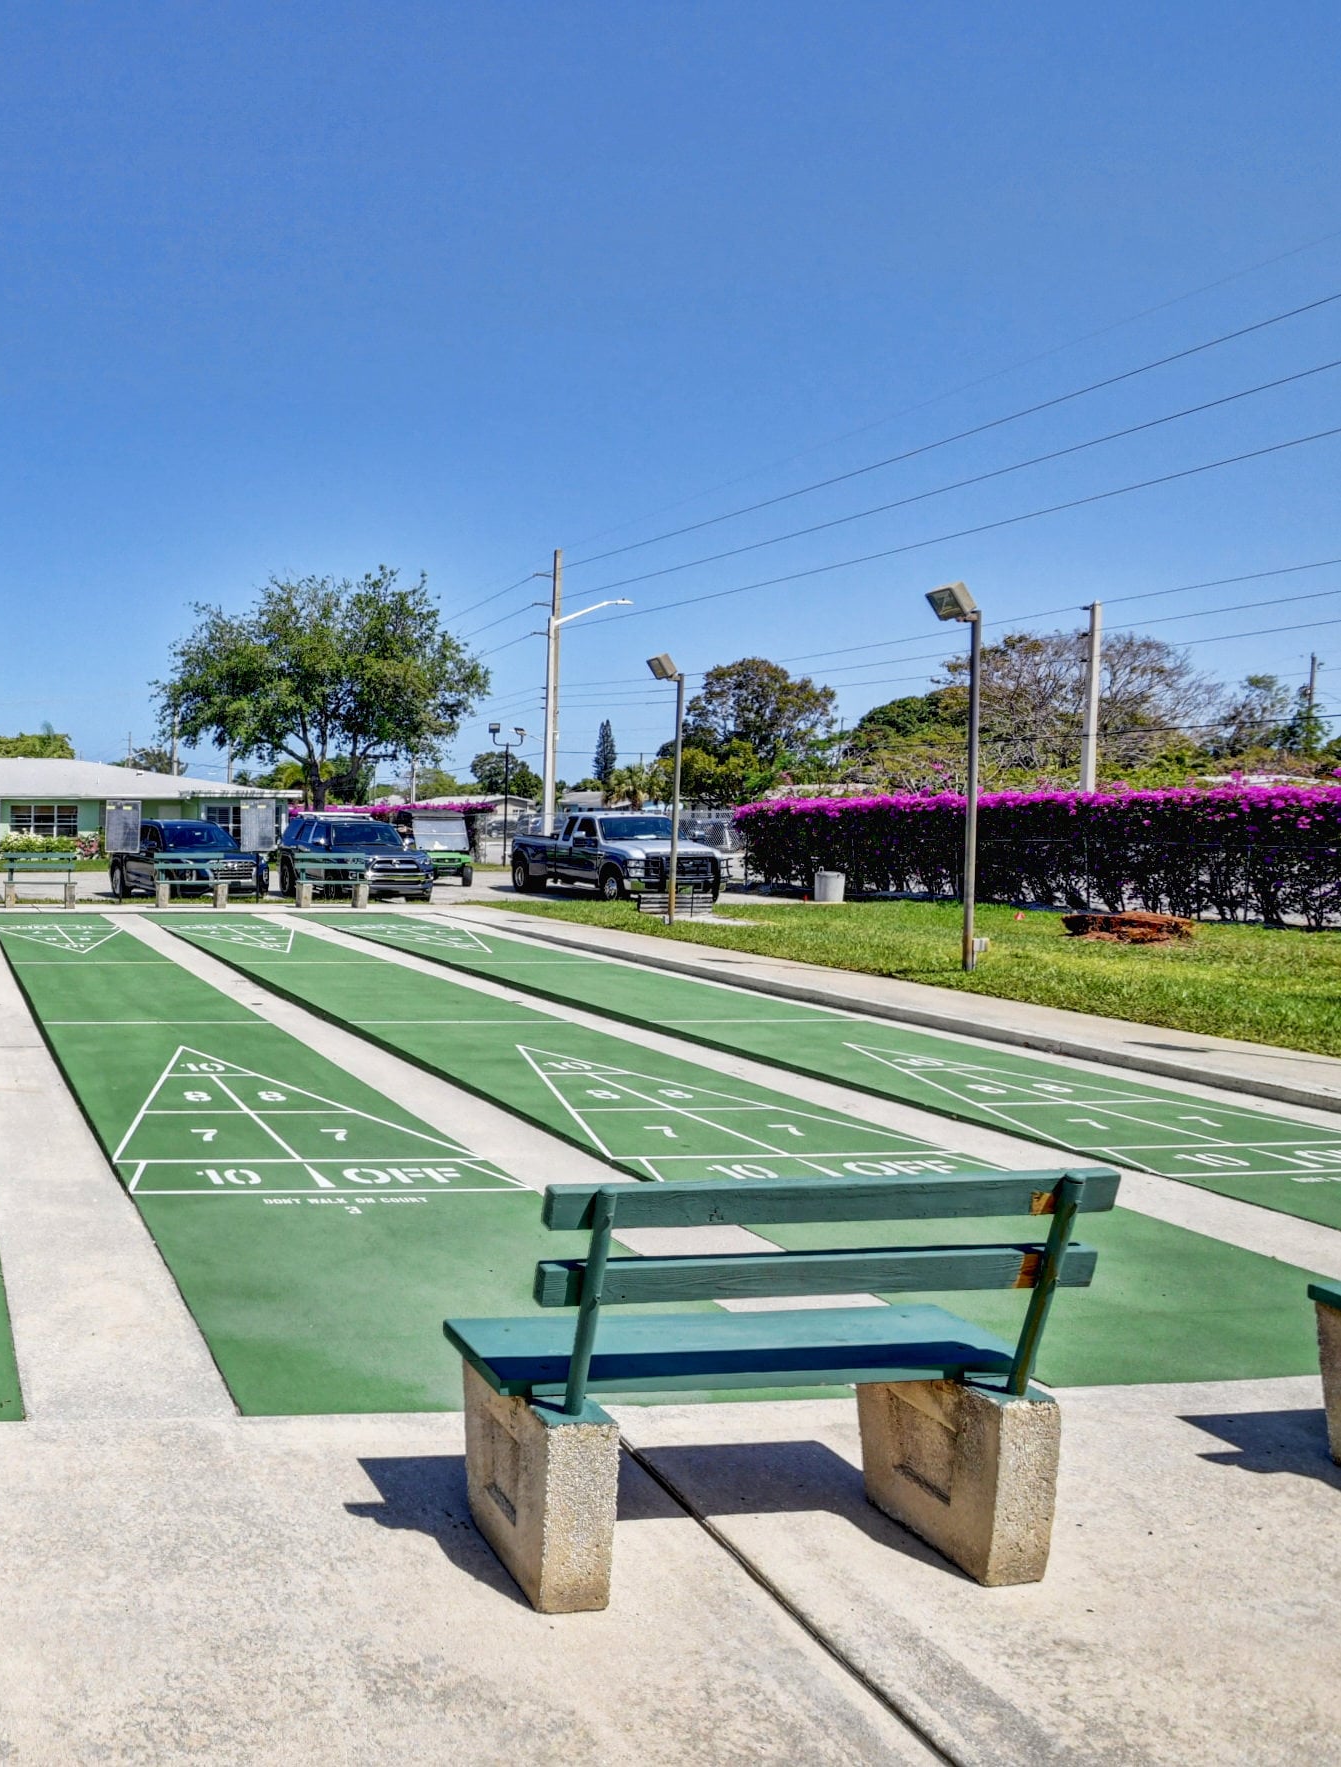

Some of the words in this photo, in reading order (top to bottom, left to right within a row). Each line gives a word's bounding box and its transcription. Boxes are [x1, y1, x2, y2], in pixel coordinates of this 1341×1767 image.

[180, 1063, 225, 1072] 10
[542, 1061, 592, 1071] 10
[183, 1090, 212, 1102] 8
[257, 1090, 287, 1102] 8
[585, 1089, 622, 1100] 8
[657, 1088, 694, 1100] 8
[190, 1128, 218, 1142] 7
[319, 1128, 348, 1142] 7
[643, 1125, 679, 1138] 7
[767, 1123, 806, 1137] 7
[705, 1163, 779, 1180] 10
[842, 1159, 958, 1177] OFF
[194, 1168, 262, 1185] 10
[342, 1167, 462, 1185] OFF
[306, 1197, 349, 1205] WALK
[379, 1196, 429, 1204] COURT
[344, 1205, 363, 1215] 3
